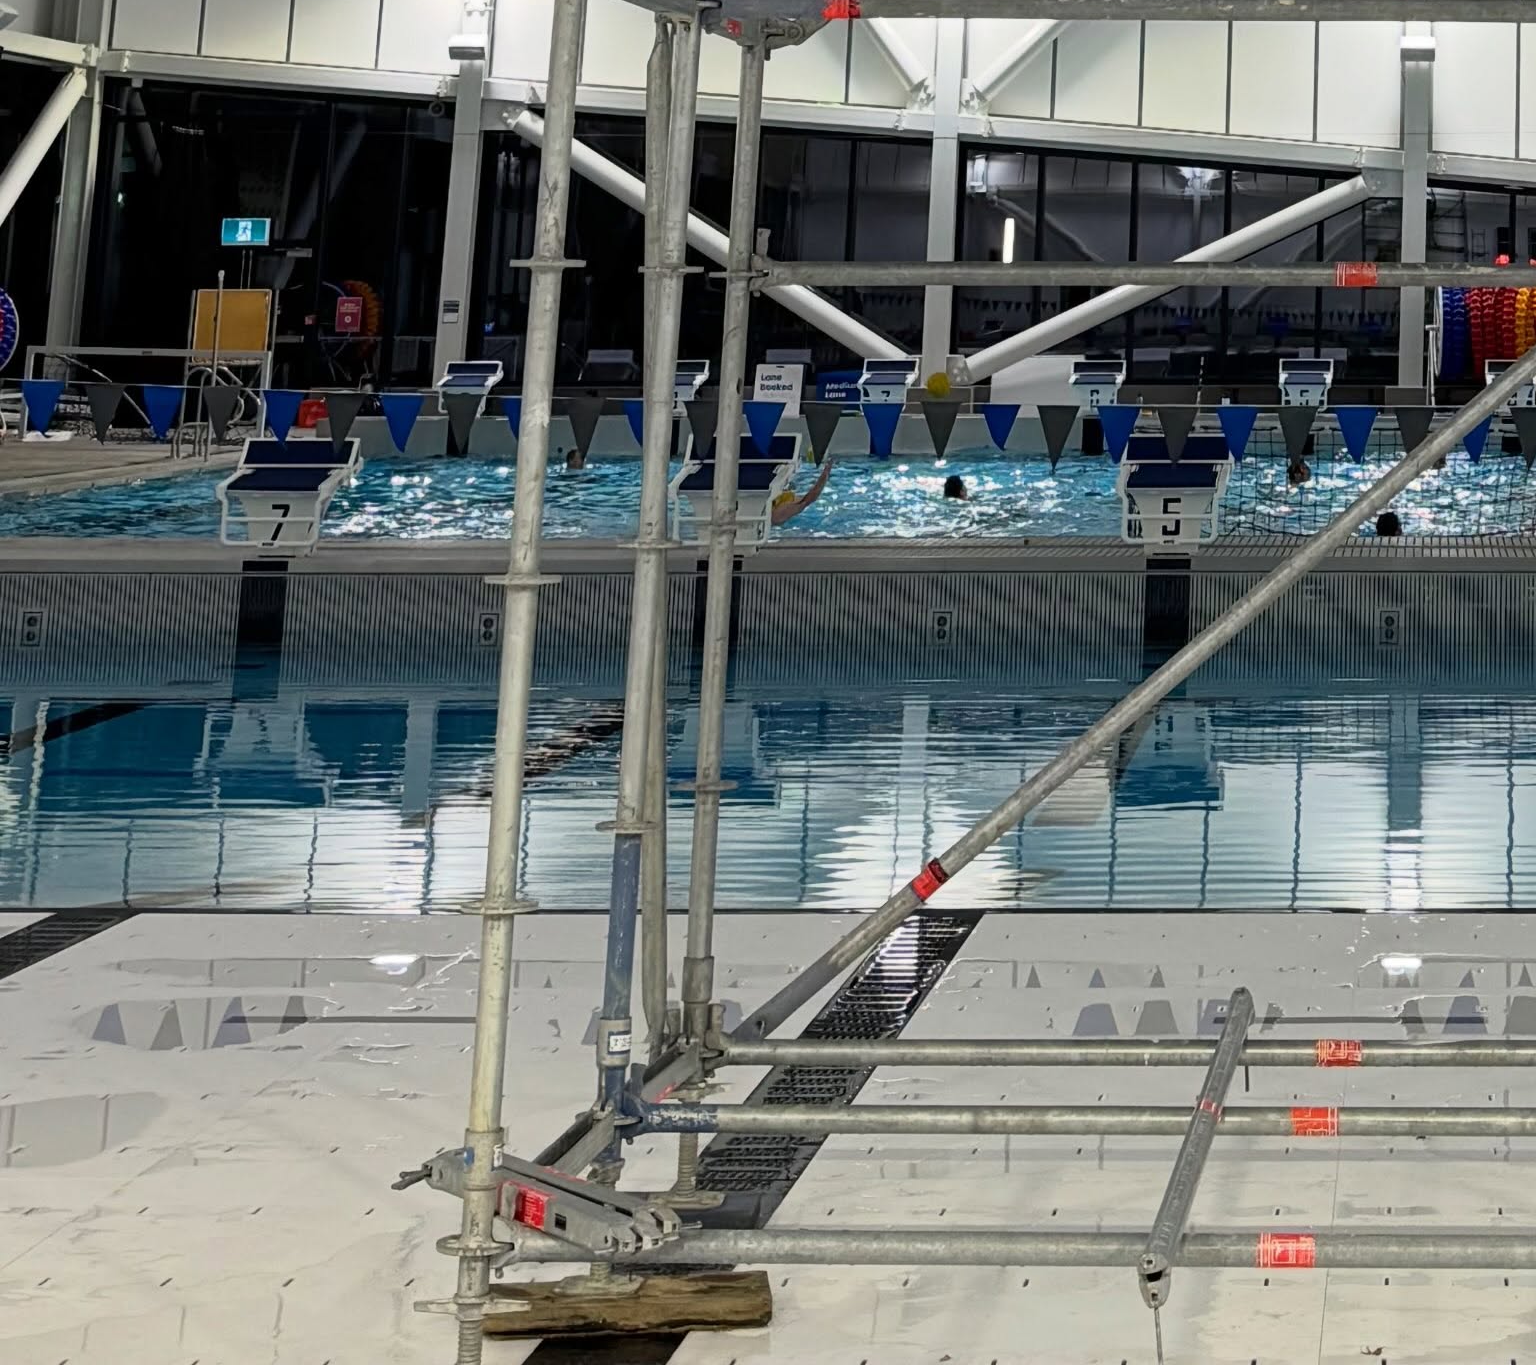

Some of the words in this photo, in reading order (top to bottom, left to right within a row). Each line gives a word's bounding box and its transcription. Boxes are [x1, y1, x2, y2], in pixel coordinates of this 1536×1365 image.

[759, 383, 794, 391] Booked
[760, 372, 783, 382] Lane
[271, 503, 291, 542] 7
[1161, 497, 1182, 536] 5
